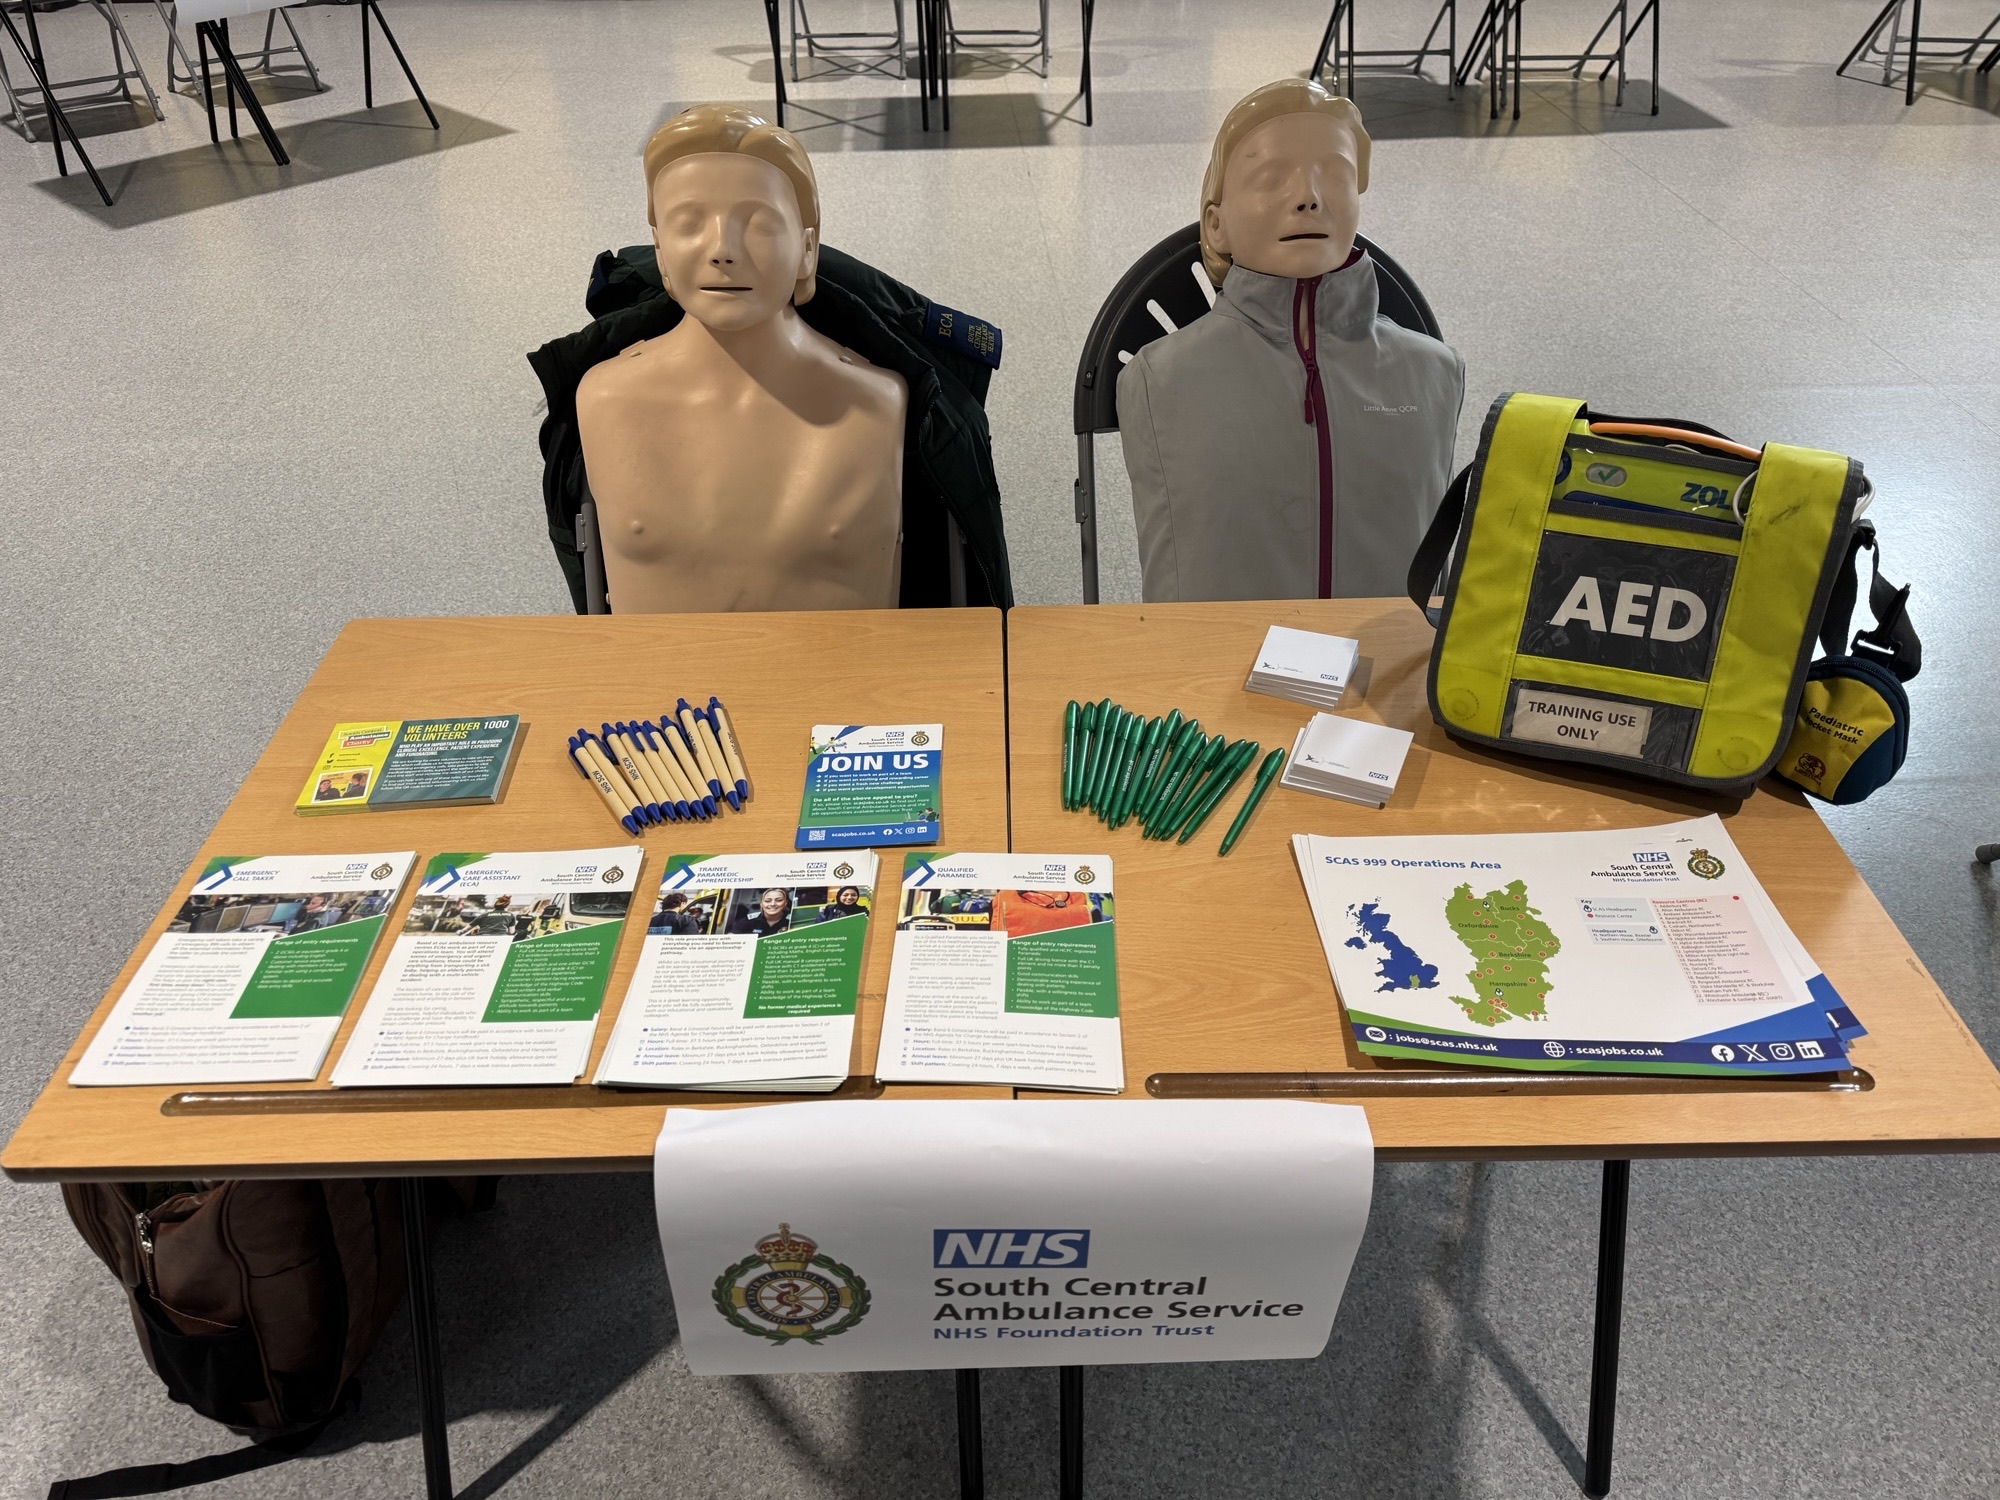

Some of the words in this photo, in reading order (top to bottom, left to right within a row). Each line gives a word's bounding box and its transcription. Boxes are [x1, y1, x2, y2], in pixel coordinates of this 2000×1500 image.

[939, 314, 952, 337] ECA
[1680, 482, 1736, 511] ZOL
[1550, 576, 1707, 642] AED
[1528, 701, 1603, 722] TRAINING
[1608, 713, 1636, 728] USE
[1809, 707, 1864, 736] Paediatric
[407, 725, 423, 733] WE
[424, 724, 452, 732] HAVE
[454, 722, 480, 731] OVER
[484, 720, 509, 729] 1000
[1557, 725, 1599, 741] ONLY
[1806, 716, 1831, 735] Pocket
[1834, 731, 1858, 745] Mask
[404, 731, 468, 742] VOLUNTEERS
[622, 757, 633, 771] SCW
[817, 755, 883, 772] JOIN
[893, 754, 929, 770] US
[592, 770, 604, 786] SCW
[629, 768, 640, 781] NHS
[1369, 772, 1388, 780] NHS
[600, 781, 612, 794] NHS
[1325, 856, 1359, 865] SCAS
[1364, 858, 1387, 866] 999
[1391, 859, 1466, 869] Operations
[1470, 861, 1502, 870] Area
[1634, 853, 1669, 862] NHS
[1396, 1034, 1498, 1051] jobs@scas.nhs.uk
[1576, 1047, 1663, 1056] scasjobs.co.uk
[936, 1231, 1088, 1267] NHS
[933, 1277, 1049, 1297] South
[1064, 1276, 1207, 1296] Central
[933, 1302, 1154, 1321] Ambulance
[1167, 1300, 1304, 1318] Service
[933, 1328, 988, 1339] NHS
[997, 1325, 1143, 1338] Foundation
[1152, 1324, 1215, 1336] Trust
